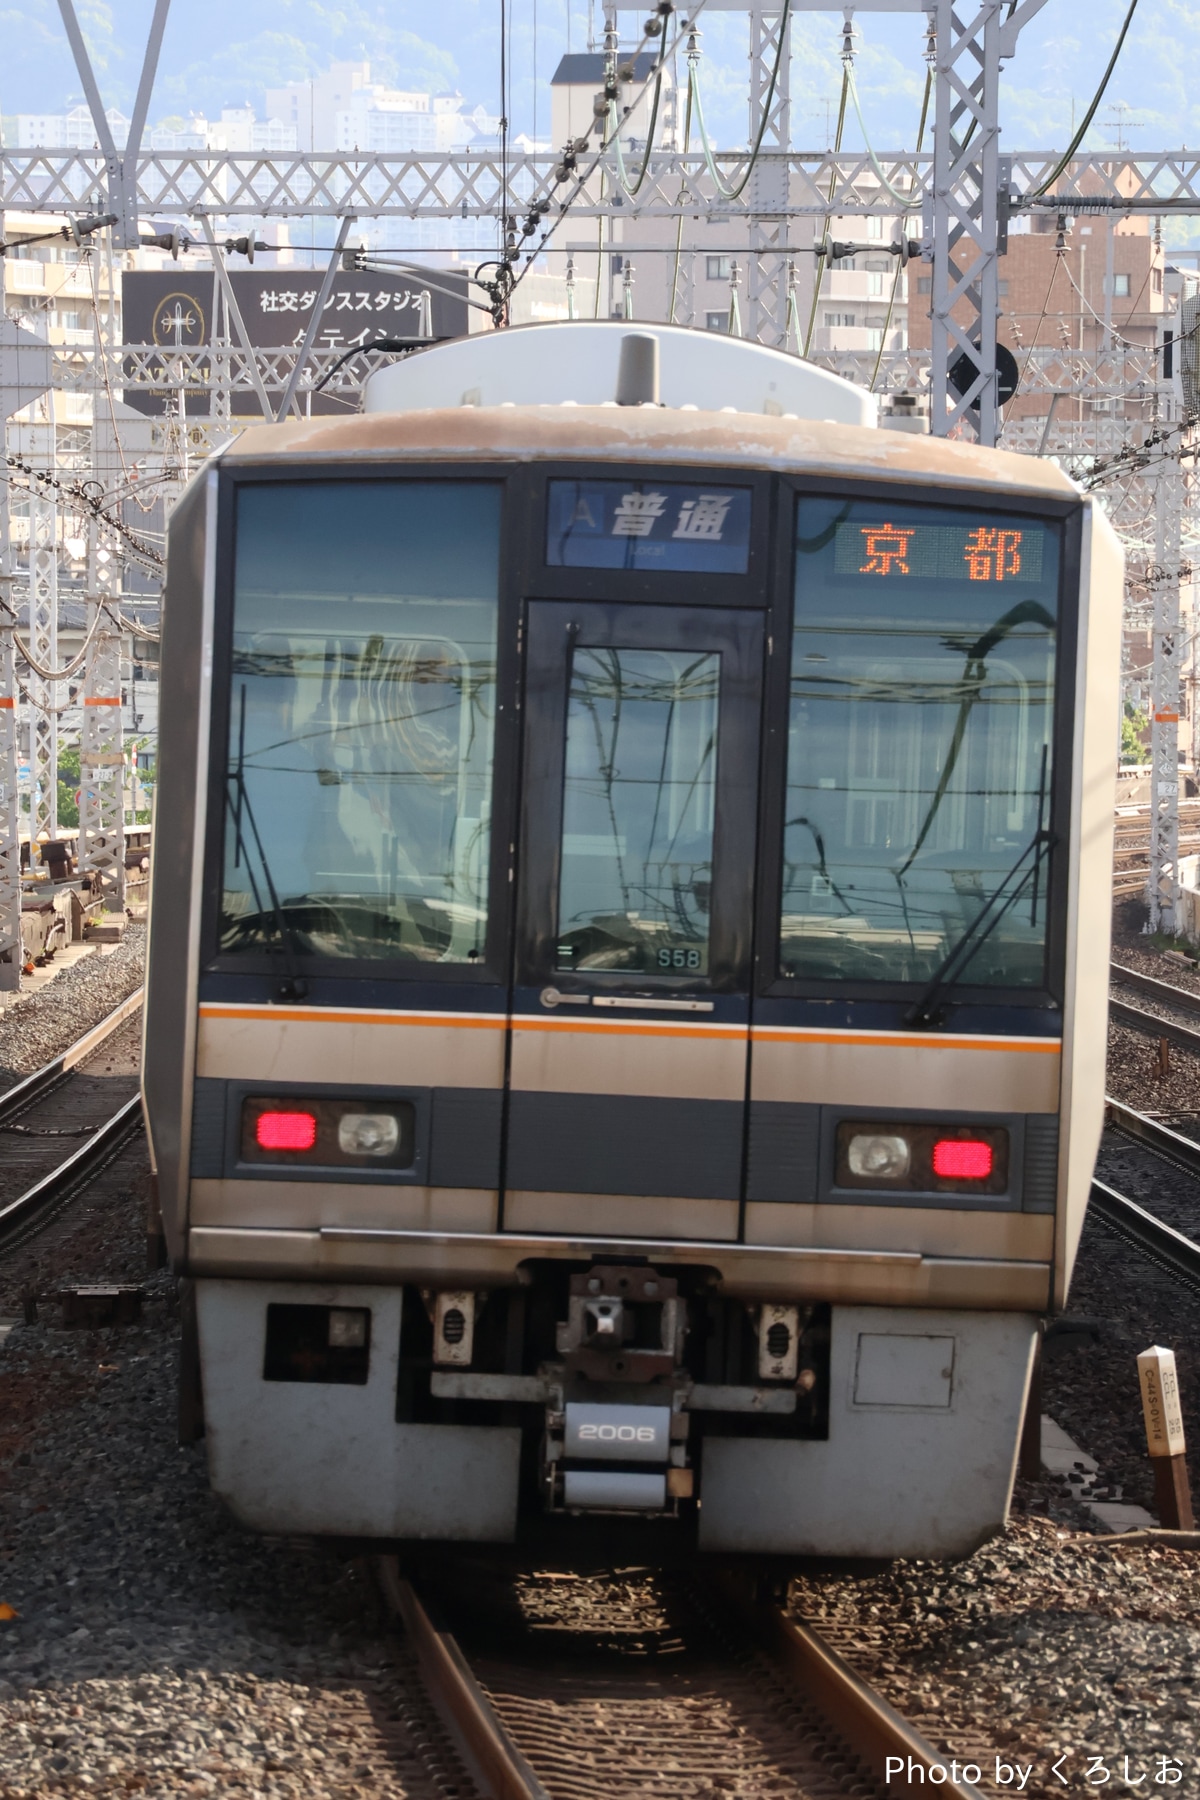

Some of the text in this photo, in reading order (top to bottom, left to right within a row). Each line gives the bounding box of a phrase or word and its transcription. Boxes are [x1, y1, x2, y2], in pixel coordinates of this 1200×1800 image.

[568, 498, 596, 528] A
[611, 491, 735, 541] 普通
[859, 522, 1022, 581] 京都
[658, 949, 700, 968] S58
[579, 1424, 656, 1441] 2006
